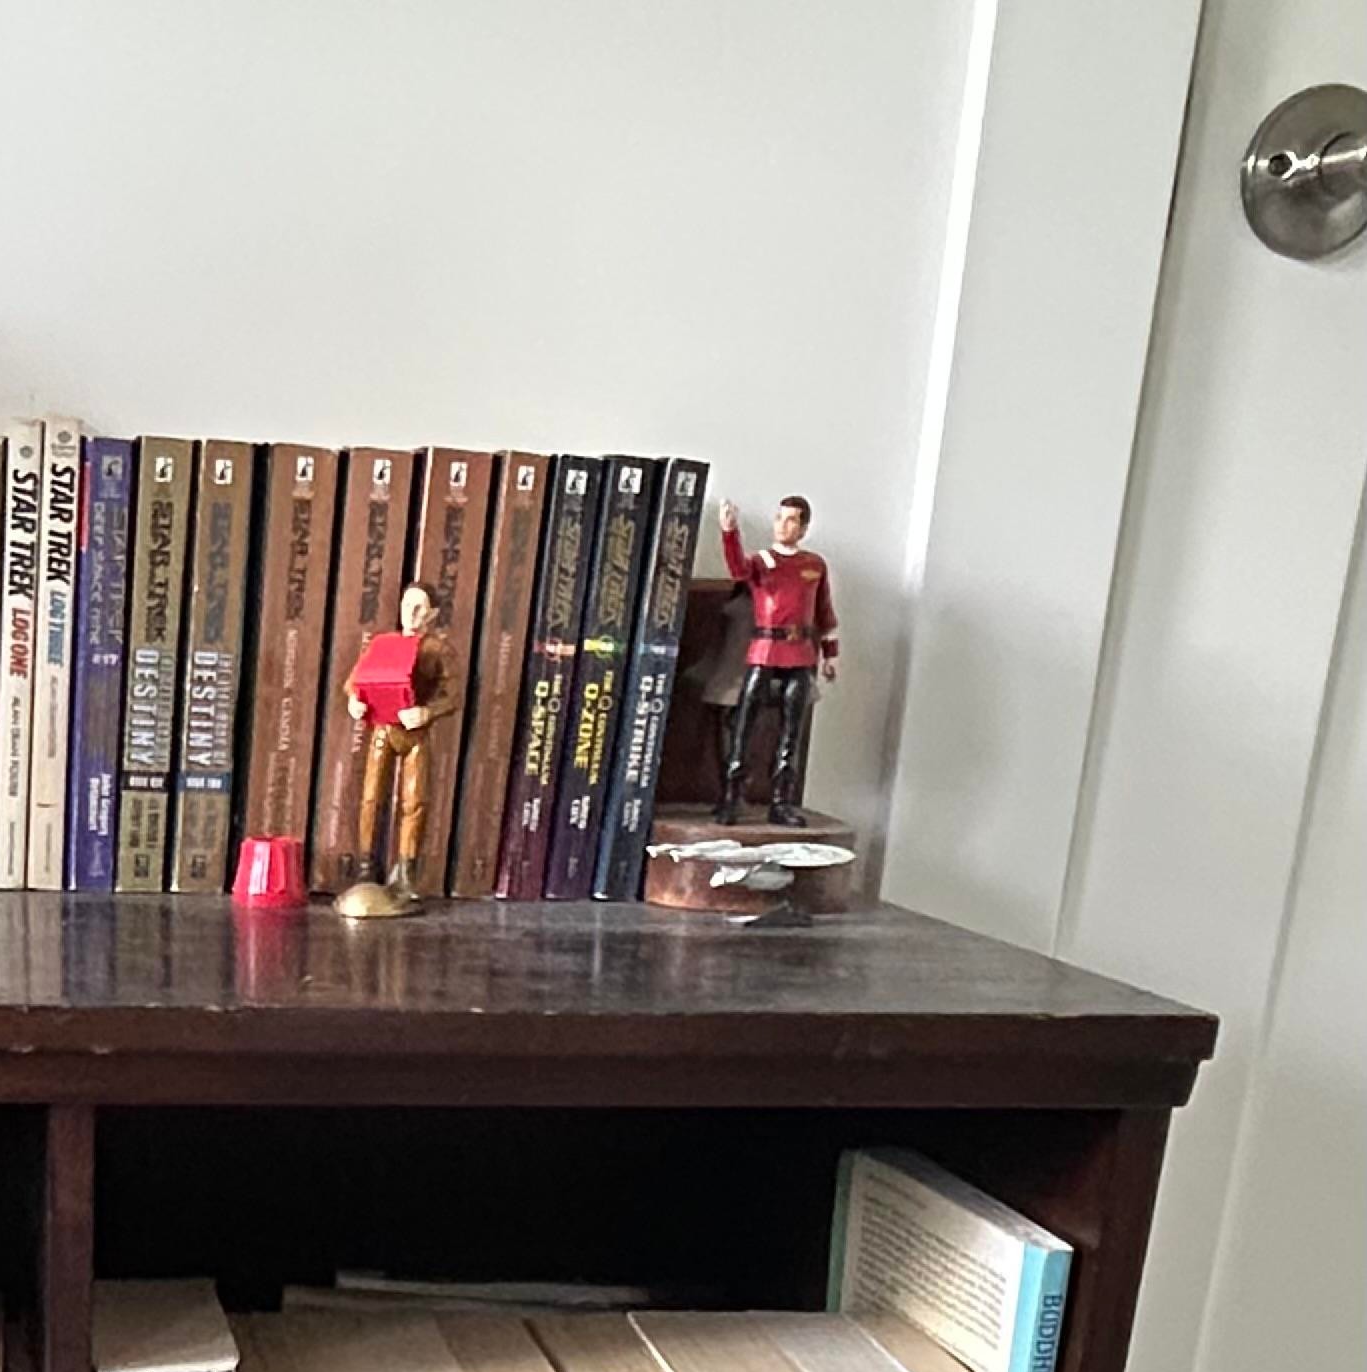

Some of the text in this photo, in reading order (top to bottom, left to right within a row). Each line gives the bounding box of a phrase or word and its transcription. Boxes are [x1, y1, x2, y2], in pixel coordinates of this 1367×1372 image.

[8, 469, 39, 679] STAR TREK LOG ONE
[45, 463, 76, 586] STAR TREK
[155, 501, 174, 567] STAR
[150, 578, 169, 644] TREK
[130, 649, 160, 766] DESTINY
[187, 650, 219, 767] DESTINY
[524, 680, 550, 776] Q-SPACE
[573, 682, 600, 769] Q-ZONE
[625, 675, 655, 783] Q-STRIKE
